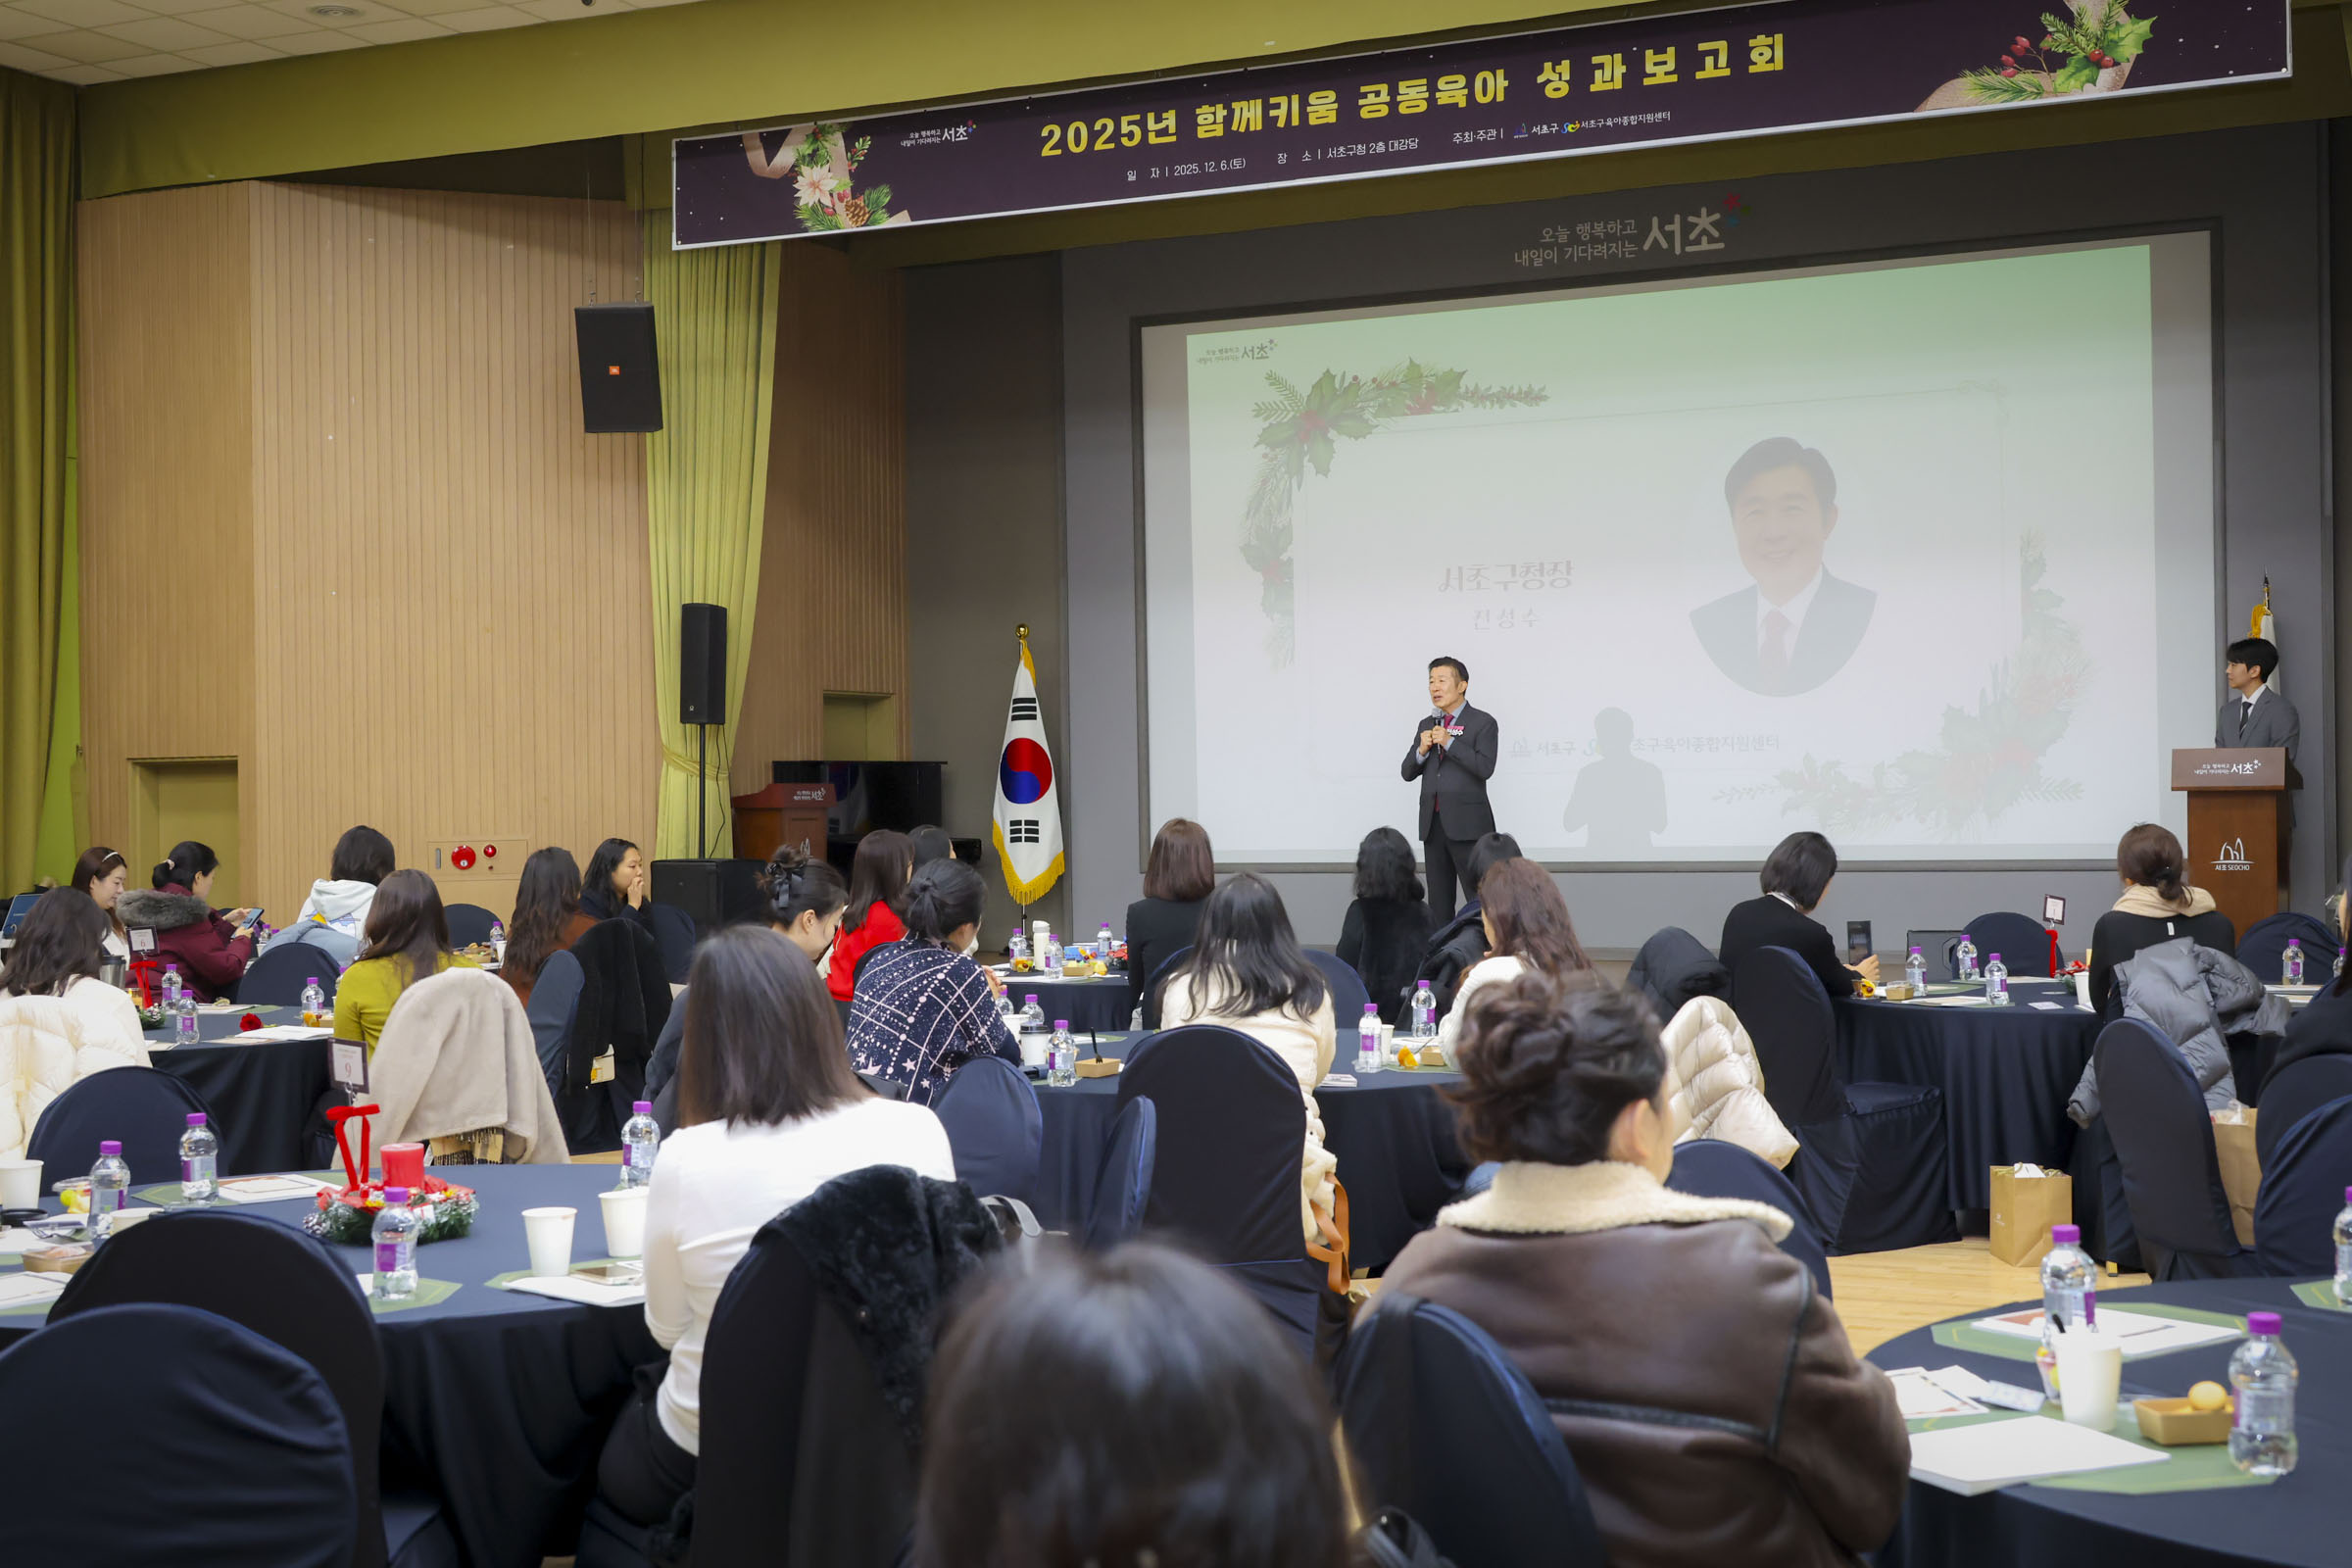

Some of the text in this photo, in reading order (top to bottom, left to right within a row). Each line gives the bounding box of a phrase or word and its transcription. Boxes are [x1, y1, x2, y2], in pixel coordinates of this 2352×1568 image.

[1041, 109, 1177, 157] 2025년
[1195, 89, 1339, 139] 함께키움
[1358, 69, 1509, 120] 공동육아
[1581, 111, 1671, 129] 서초구육아종합지원센터
[942, 125, 968, 142] 서초
[1531, 123, 1559, 135] 서초구
[1327, 144, 1366, 159] 서초구청
[1369, 141, 1386, 154] 2층
[1389, 137, 1419, 152] 대강당
[1540, 219, 1638, 243] 오늘 행복하고
[1642, 206, 1725, 255] 서초
[1515, 239, 1639, 267] 내일이 기다려지는
[1242, 343, 1269, 360] 서초
[1437, 560, 1575, 593] 서초구청장
[1631, 734, 1780, 753] 초구육아종합지원센터
[2230, 762, 2254, 774] 서초
[345, 1061, 352, 1078] 9
